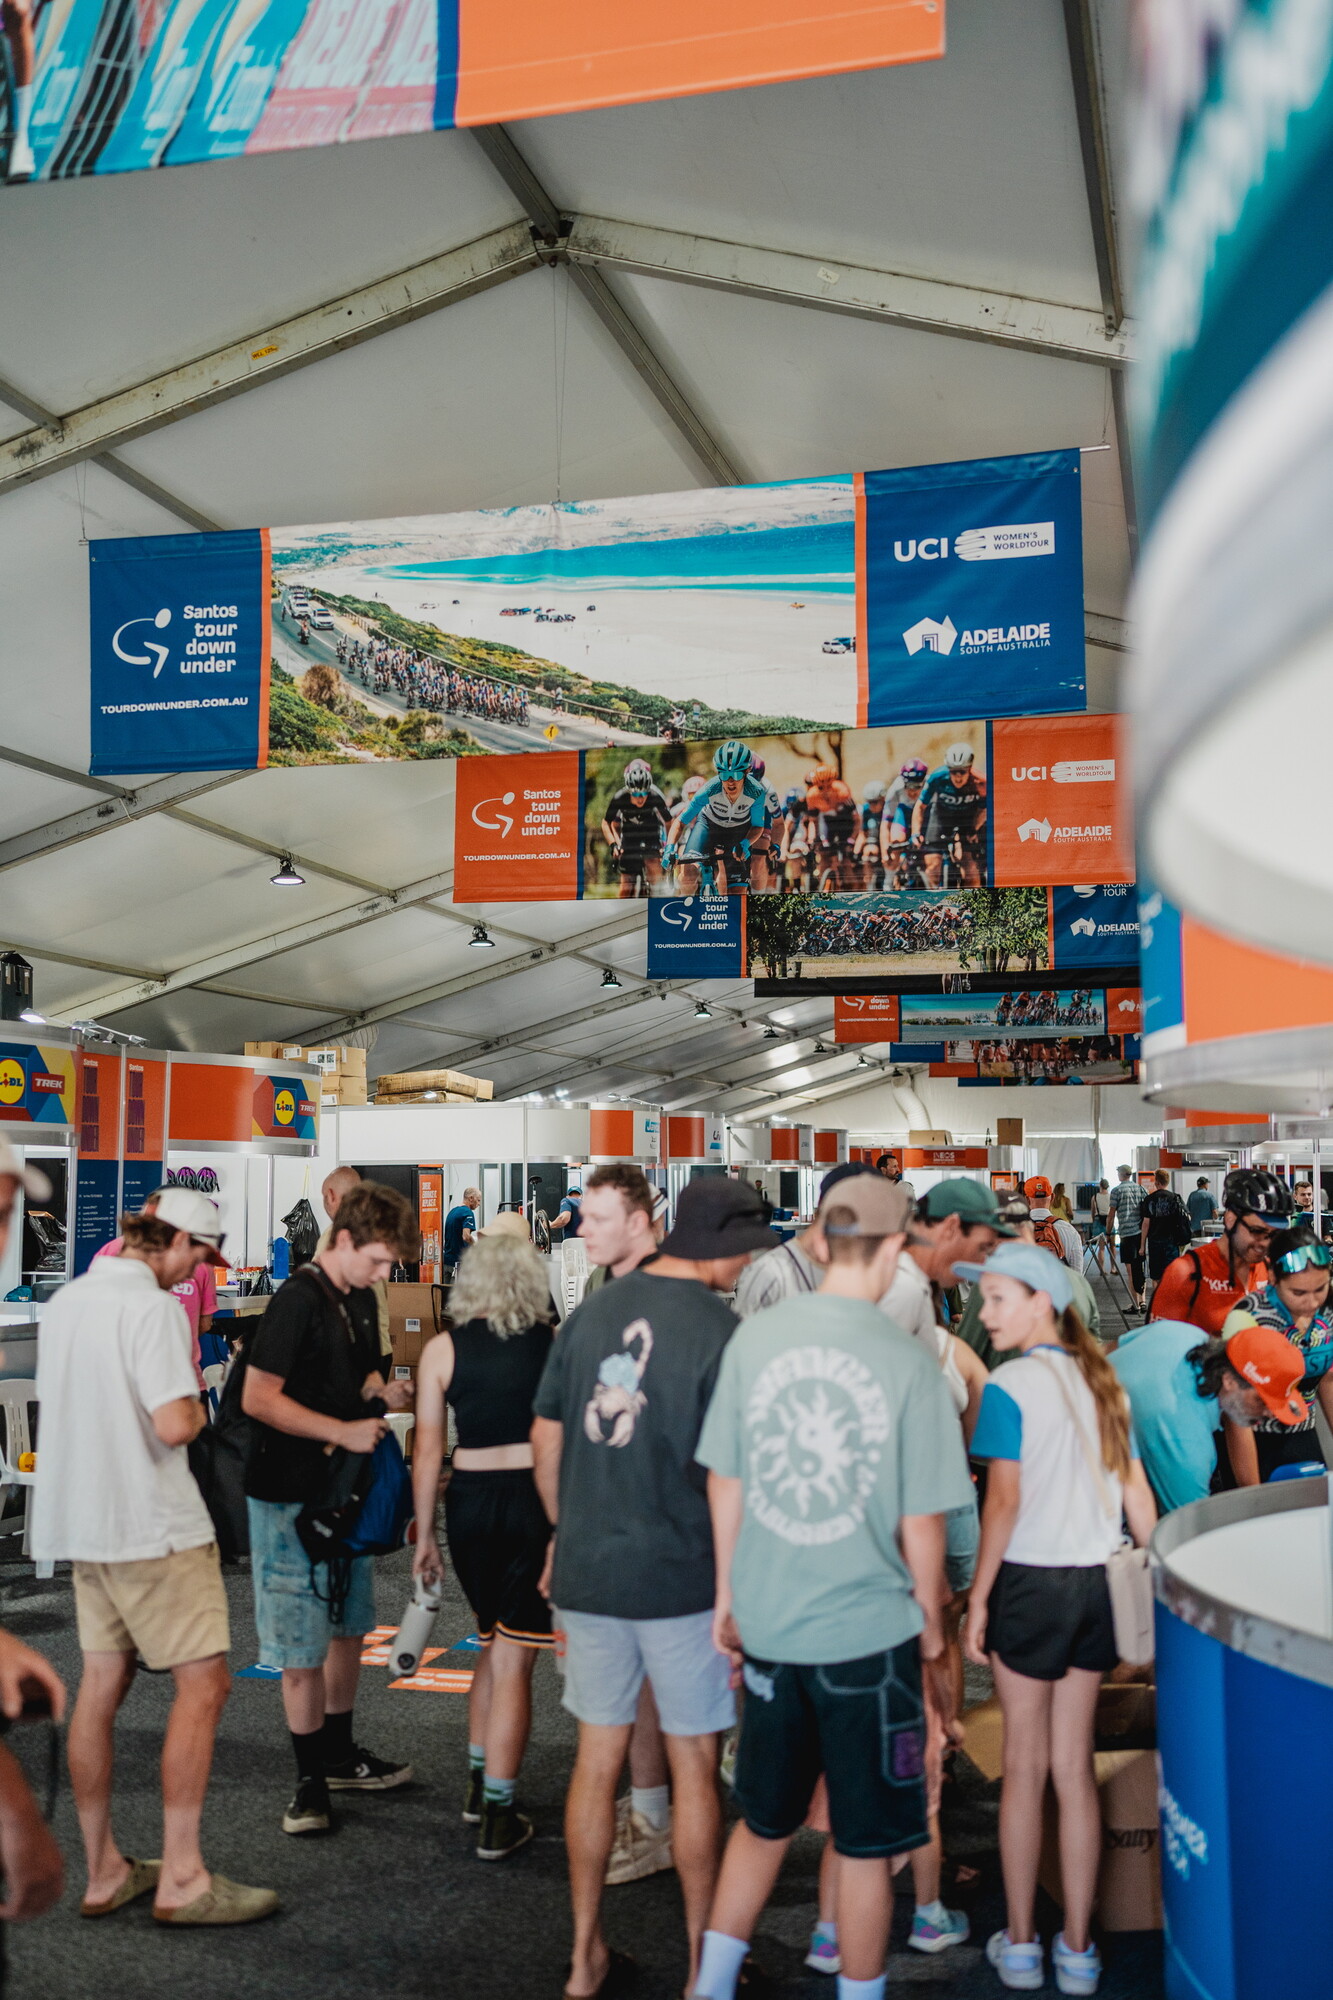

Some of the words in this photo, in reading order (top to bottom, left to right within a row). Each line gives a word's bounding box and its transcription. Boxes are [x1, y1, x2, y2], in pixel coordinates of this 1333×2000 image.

[993, 531, 1038, 542] WOMEN'S
[894, 537, 948, 562] UCI
[993, 539, 1049, 551] WORLDTOUR
[183, 604, 238, 620] Santos
[195, 622, 238, 637] tour
[960, 623, 1050, 647] ADELAIDE
[185, 639, 237, 656] down
[960, 644, 994, 656] SOUTH
[996, 639, 1051, 652] AUSTRALIA
[180, 657, 237, 674] under
[101, 697, 249, 714] TOURDOWNUNDER.COM.AU
[1011, 766, 1047, 781] UCI
[523, 789, 561, 800] Santos
[531, 801, 561, 812] tour
[524, 813, 561, 824] down
[521, 824, 561, 836] under
[1053, 825, 1112, 838] ADELAIDE
[1077, 835, 1112, 843] AUSTRALIA
[463, 852, 571, 862] TOURDOWNUNDER.COM.AU
[1103, 888, 1128, 897] TOUR
[705, 904, 729, 912] tour
[701, 911, 728, 921] down
[698, 921, 729, 930] under
[1097, 923, 1140, 932] ADELAIDE
[35, 1078, 63, 1089] TREK
[300, 1104, 316, 1112] TREK
[933, 1151, 955, 1159] INEOS
